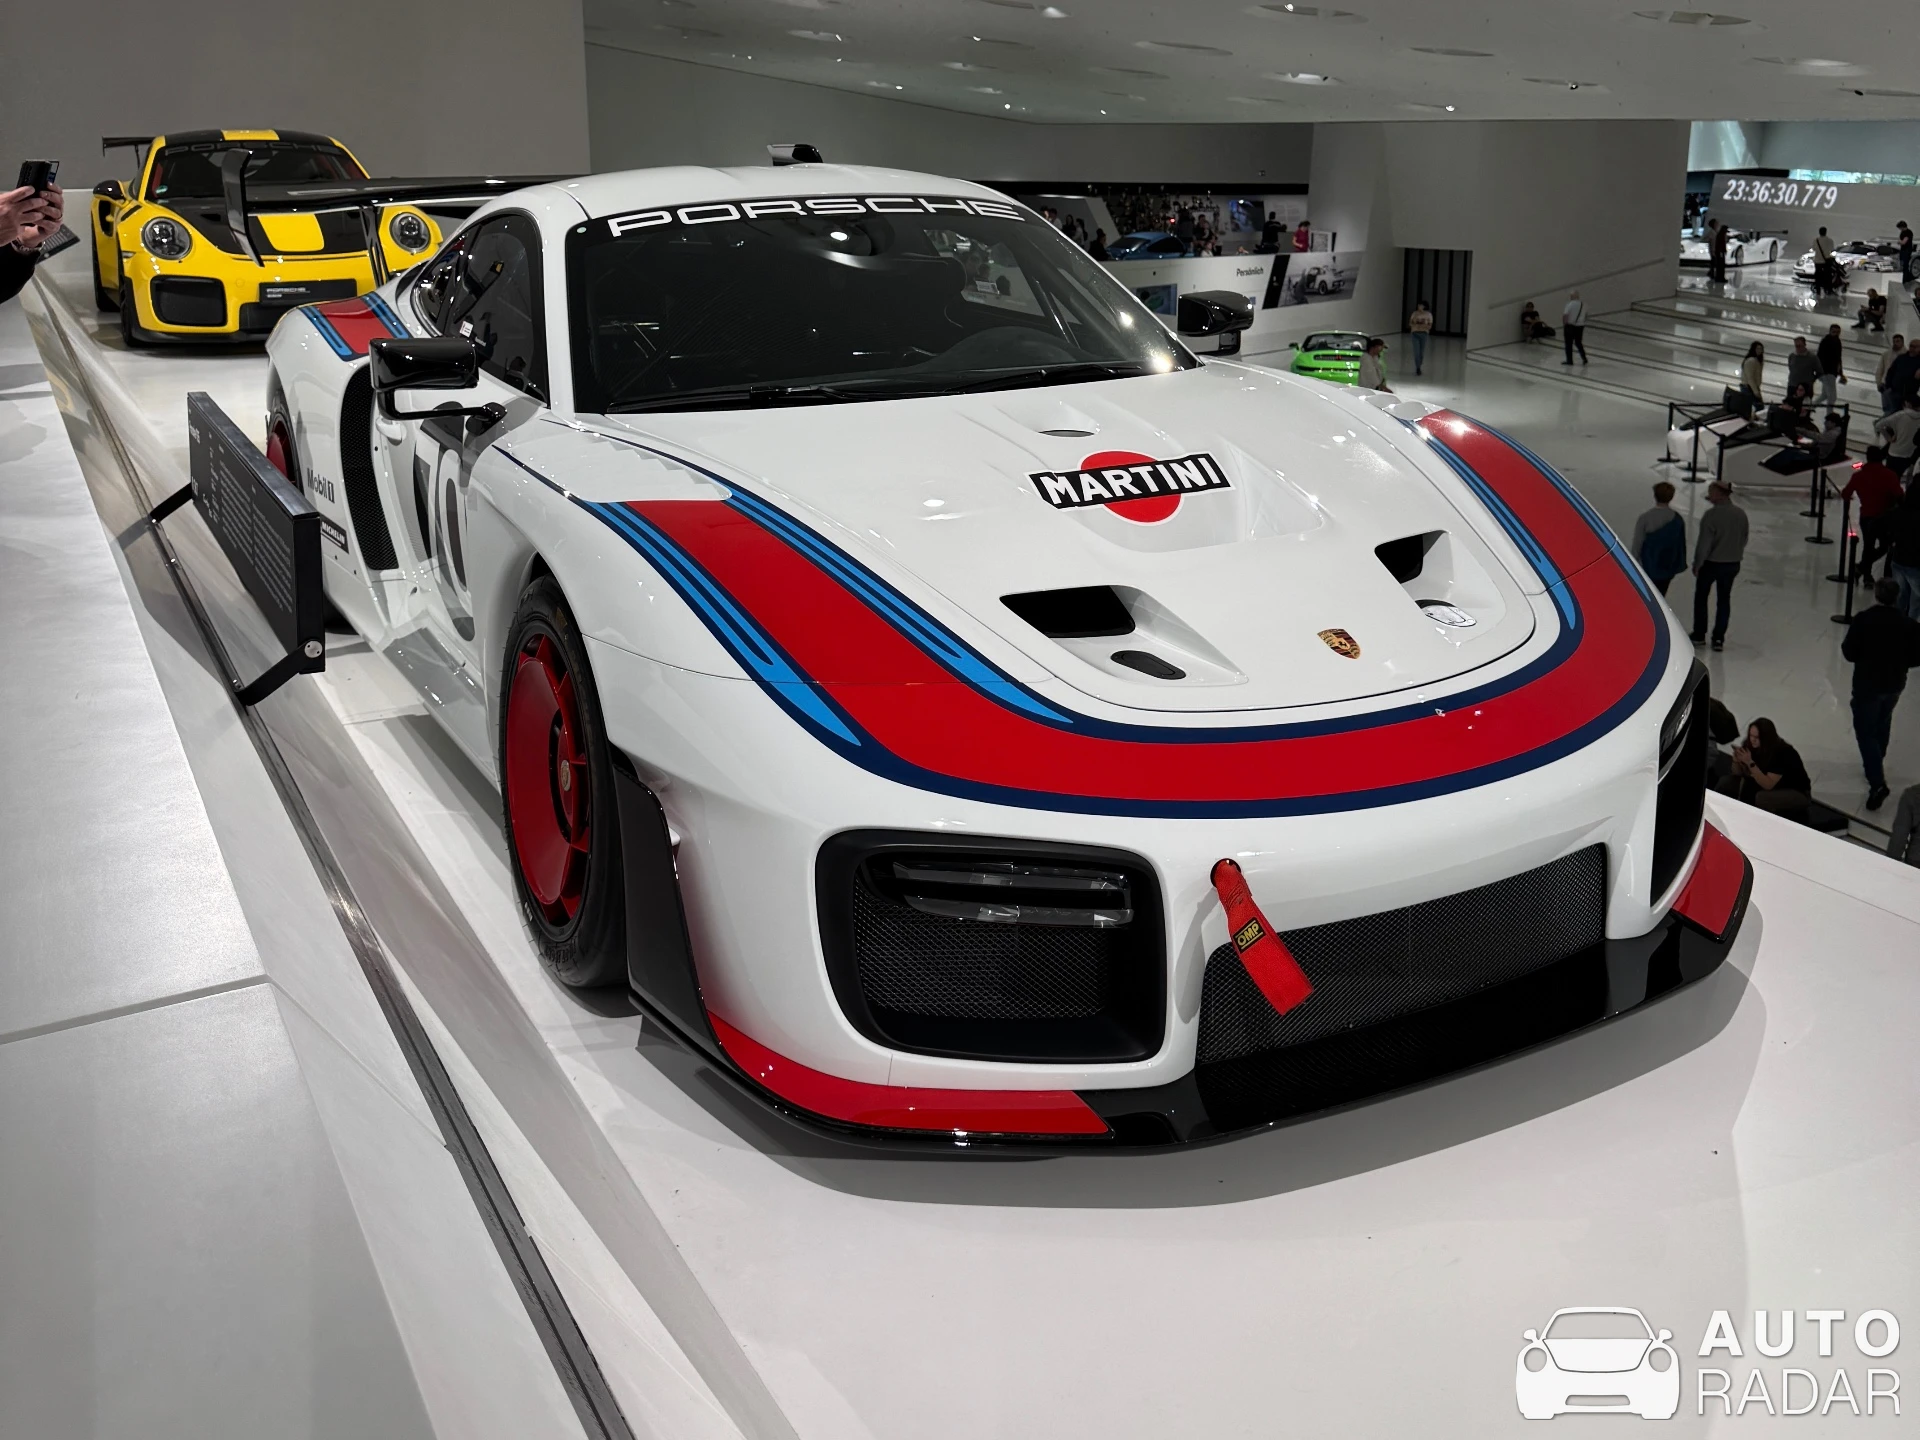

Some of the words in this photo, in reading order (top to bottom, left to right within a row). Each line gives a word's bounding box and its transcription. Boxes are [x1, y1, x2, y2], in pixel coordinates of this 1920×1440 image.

[1723, 179, 1838, 209] 23:36:30.779
[607, 197, 1025, 237] PORSCHE
[1236, 266, 1264, 276] Persönlich
[307, 467, 327, 499] Mobil
[1040, 457, 1221, 505] MARTINI
[321, 521, 346, 545] MICHELIN
[1237, 923, 1259, 946] OMP
